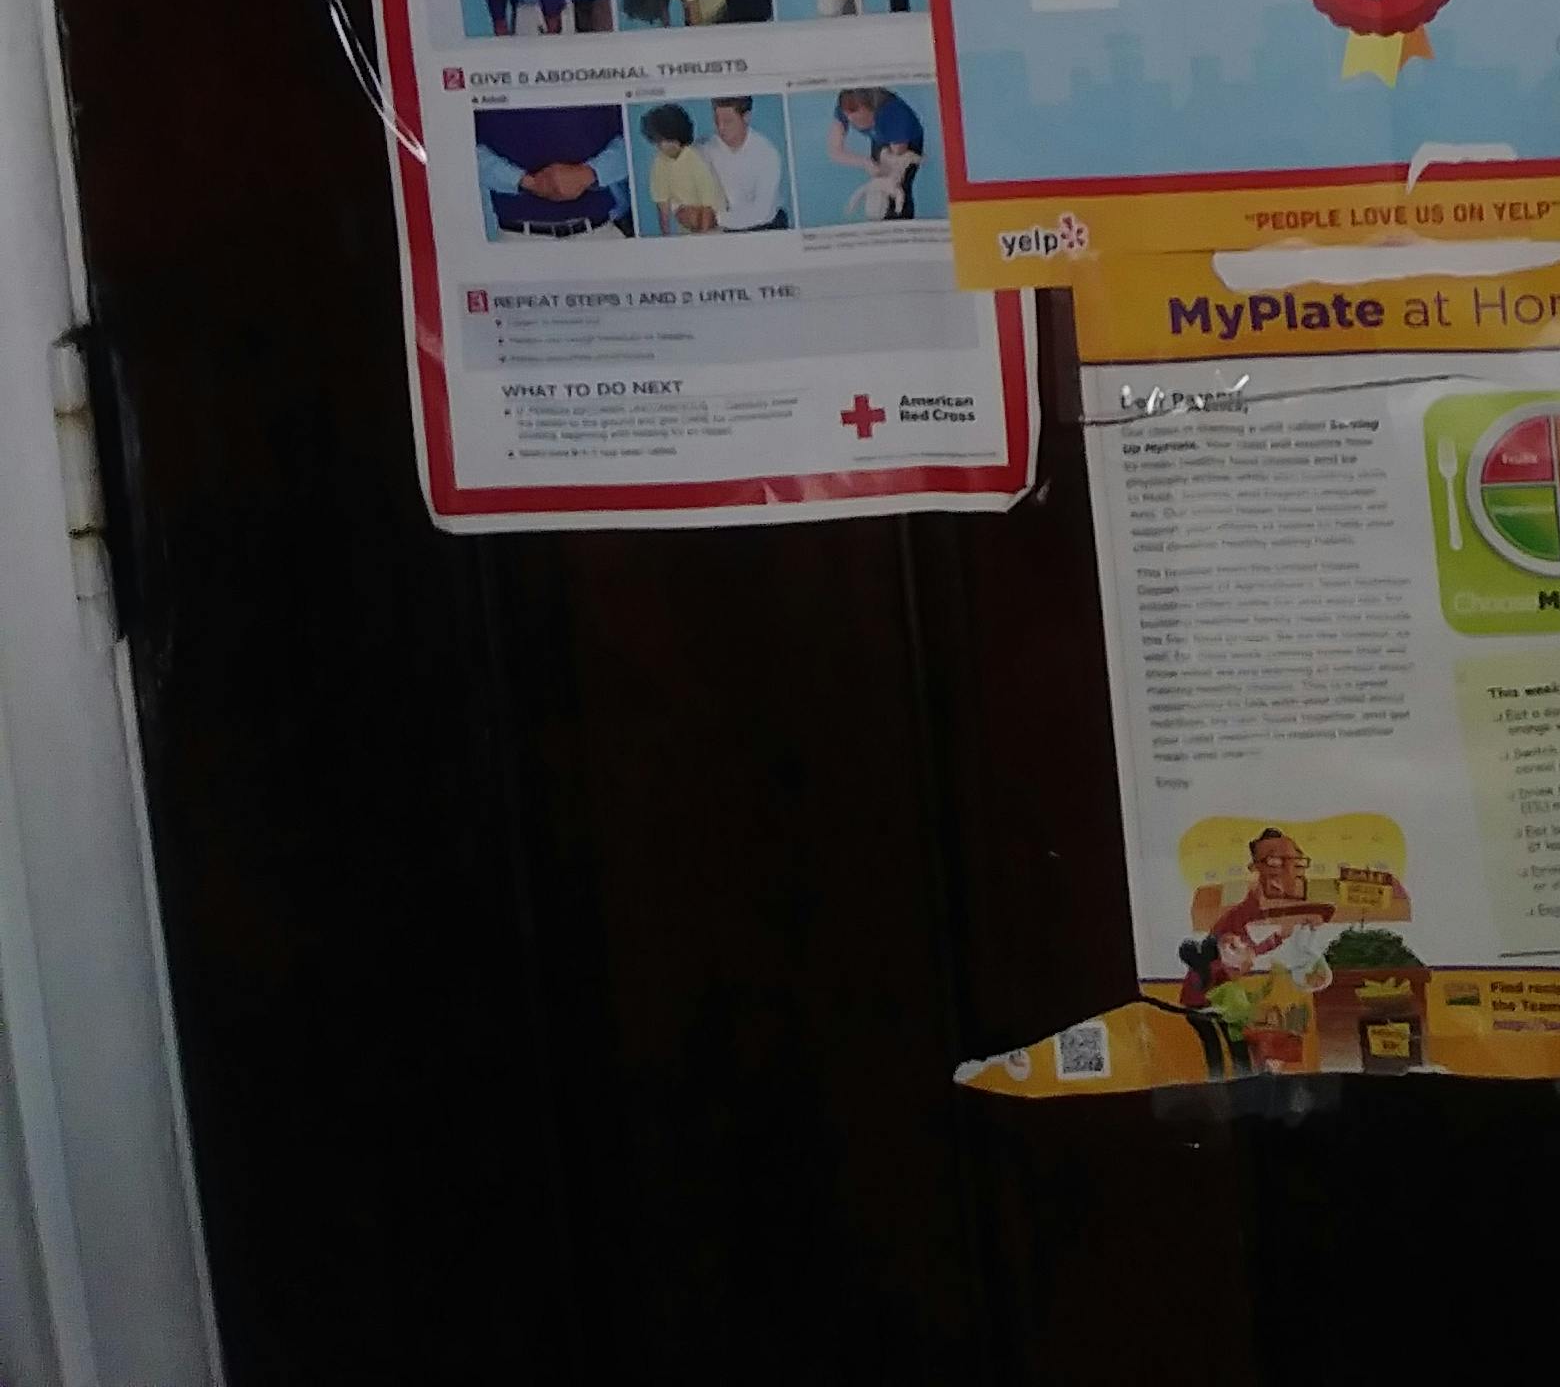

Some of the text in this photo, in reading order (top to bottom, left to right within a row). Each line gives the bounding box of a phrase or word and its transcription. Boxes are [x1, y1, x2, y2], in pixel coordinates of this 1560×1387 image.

[470, 73, 512, 87] GIVE
[534, 66, 649, 85] ABDOMINAL
[657, 59, 748, 77] THRUSTS
[1244, 200, 1560, 232] "PEOPLE LOVE US ON YELP"
[1000, 230, 1059, 258] yelp
[494, 292, 560, 309] REPEAT
[565, 292, 620, 308] STEPS
[639, 291, 677, 307] AND
[700, 288, 750, 303] UNTIL
[1168, 293, 1386, 340] MyPlate
[1403, 291, 1452, 327] at
[502, 380, 684, 399] WHAT TO DO NEXT
[899, 394, 974, 410] American
[899, 408, 976, 424] Red Cross
[1490, 981, 1524, 994] Find
[1491, 1000, 1517, 1012] the
